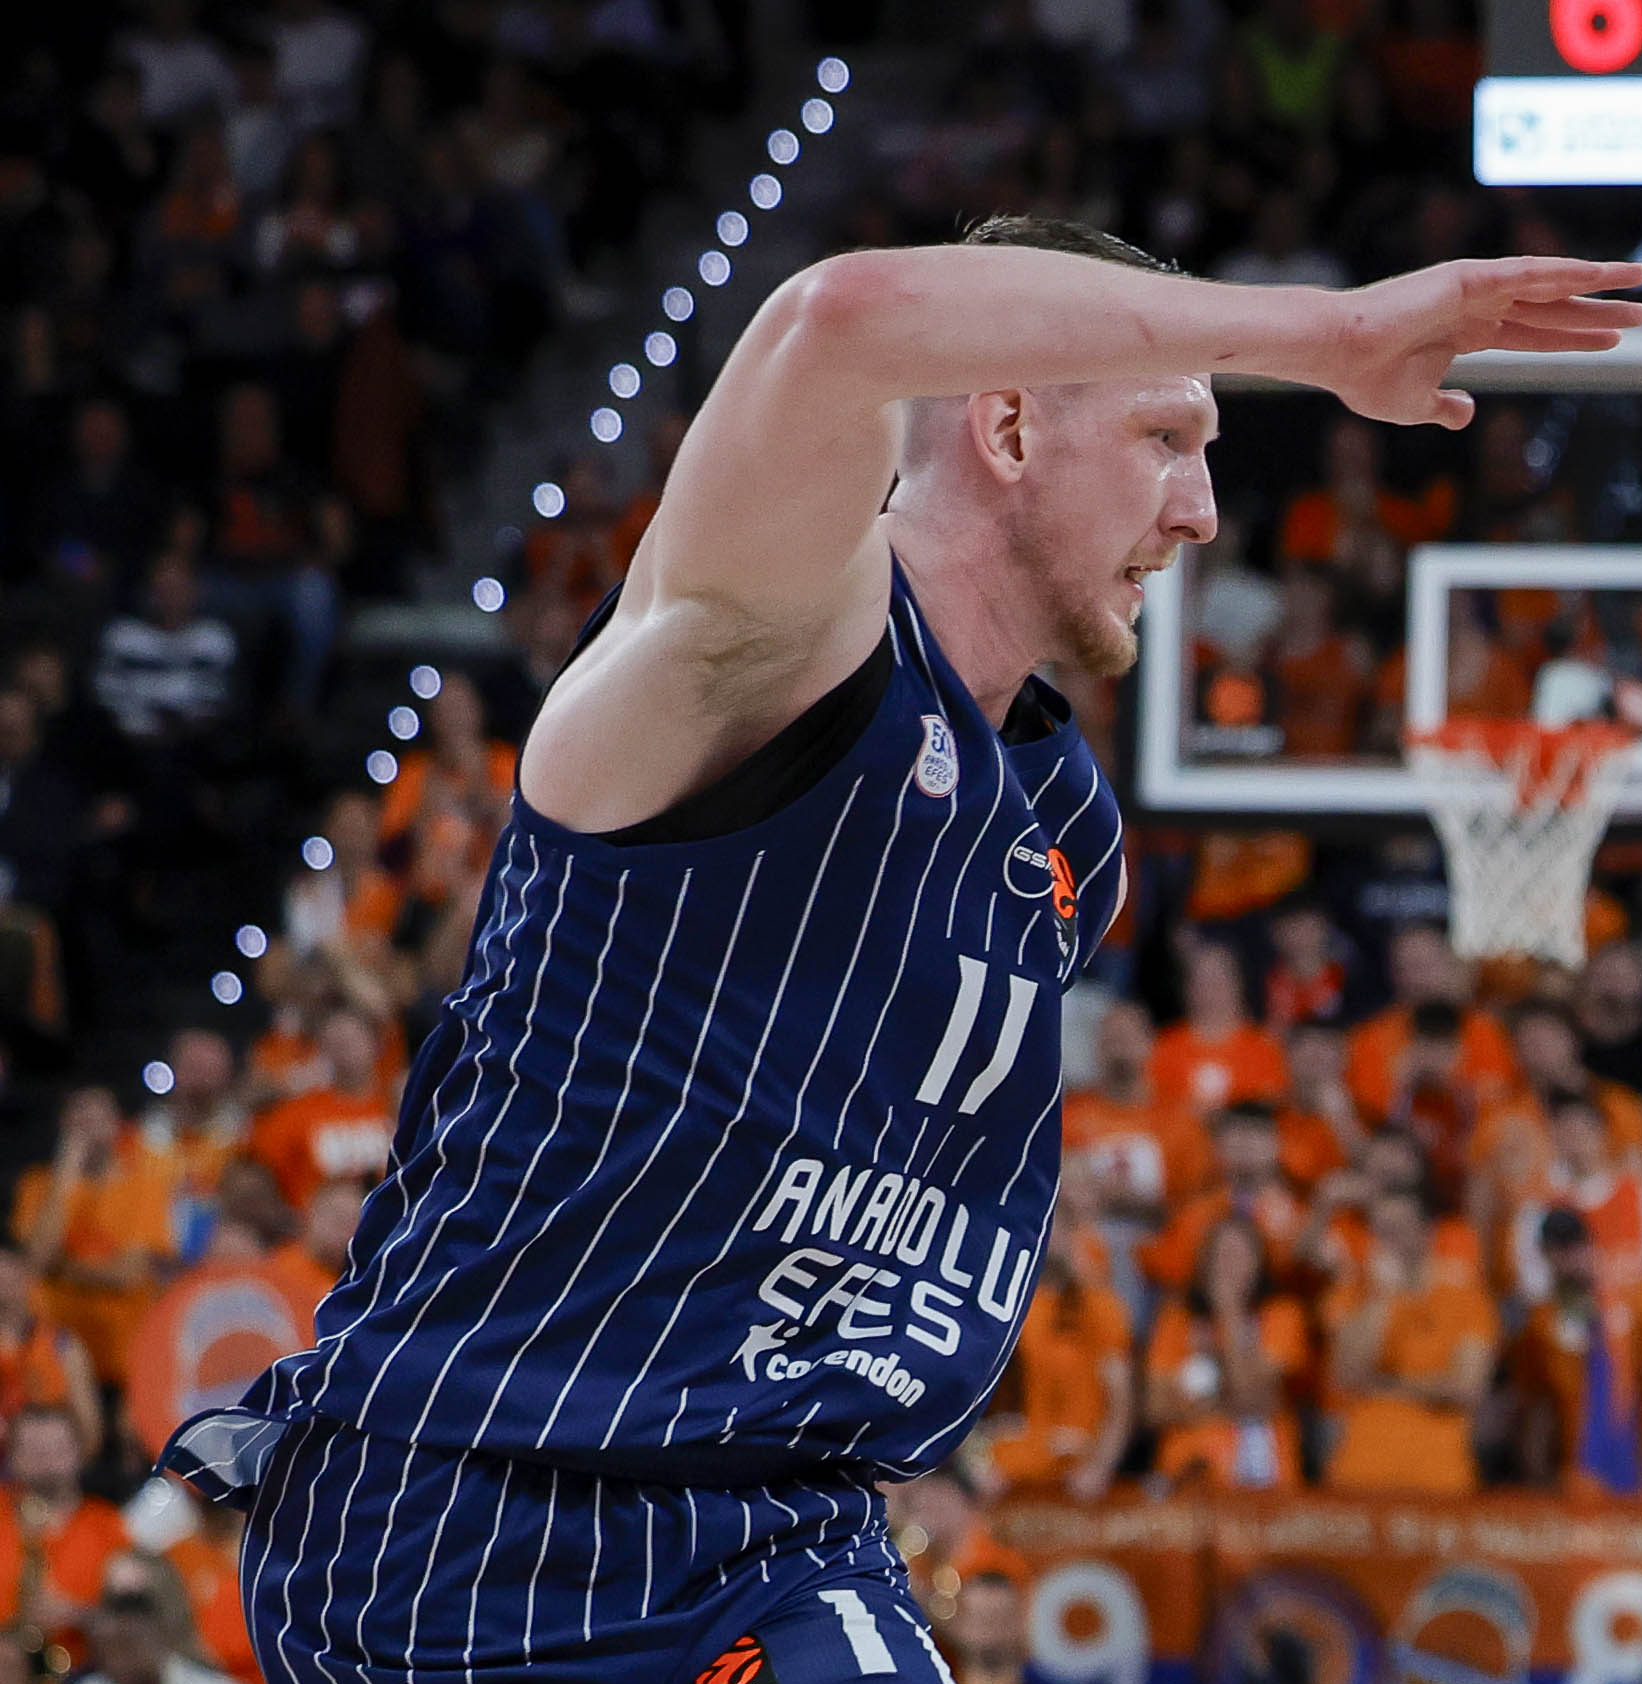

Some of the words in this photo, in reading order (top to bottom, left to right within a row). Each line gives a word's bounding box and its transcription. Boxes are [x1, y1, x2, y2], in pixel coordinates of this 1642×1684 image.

[914, 953, 1039, 1116] 11
[752, 1158, 1031, 1323] ANADOLU
[758, 1247, 964, 1357] EFES
